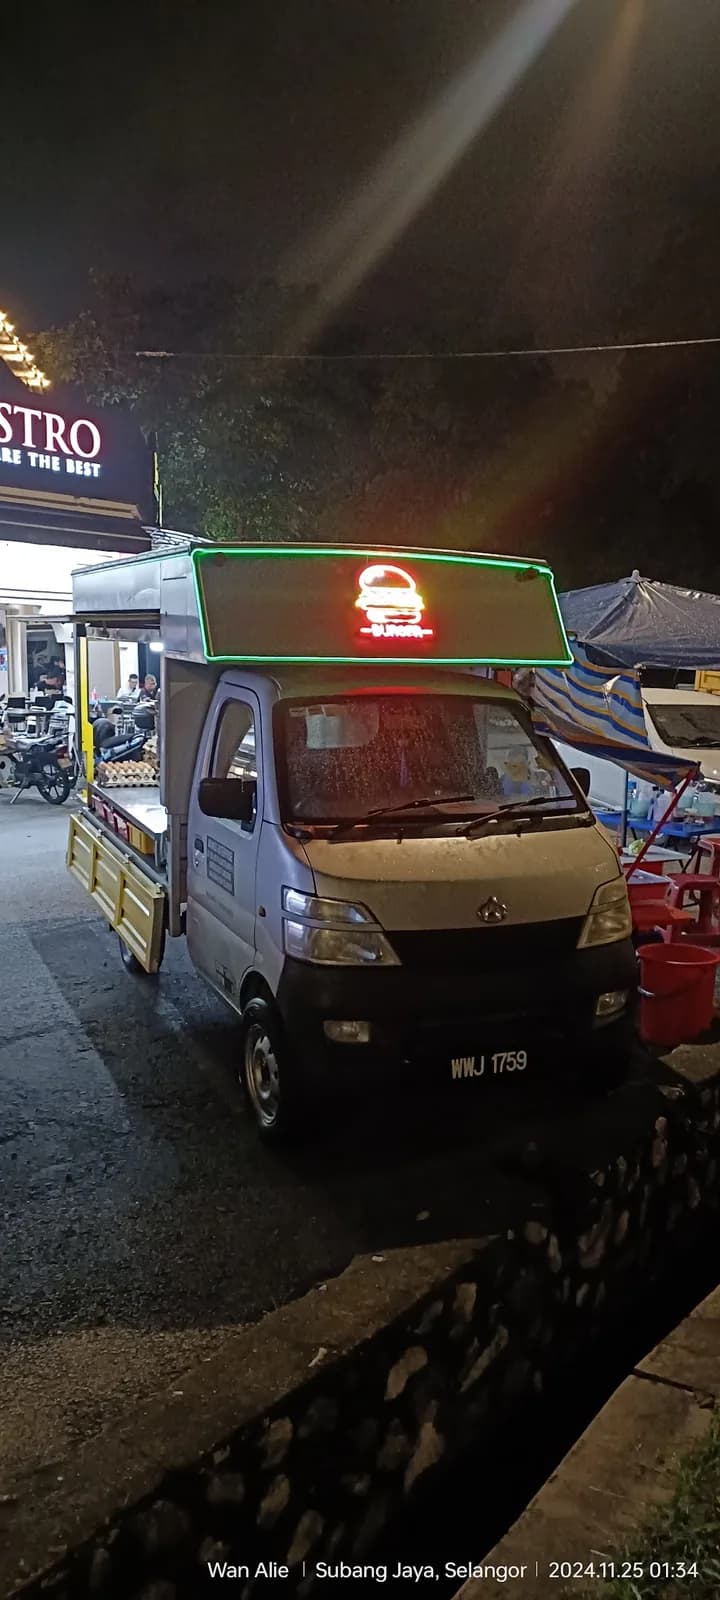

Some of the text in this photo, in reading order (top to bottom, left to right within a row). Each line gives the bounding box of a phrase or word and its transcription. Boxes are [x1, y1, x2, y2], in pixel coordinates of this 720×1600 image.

[0, 447, 101, 478] RE THE BEST
[451, 1050, 527, 1079] WWJ 1759
